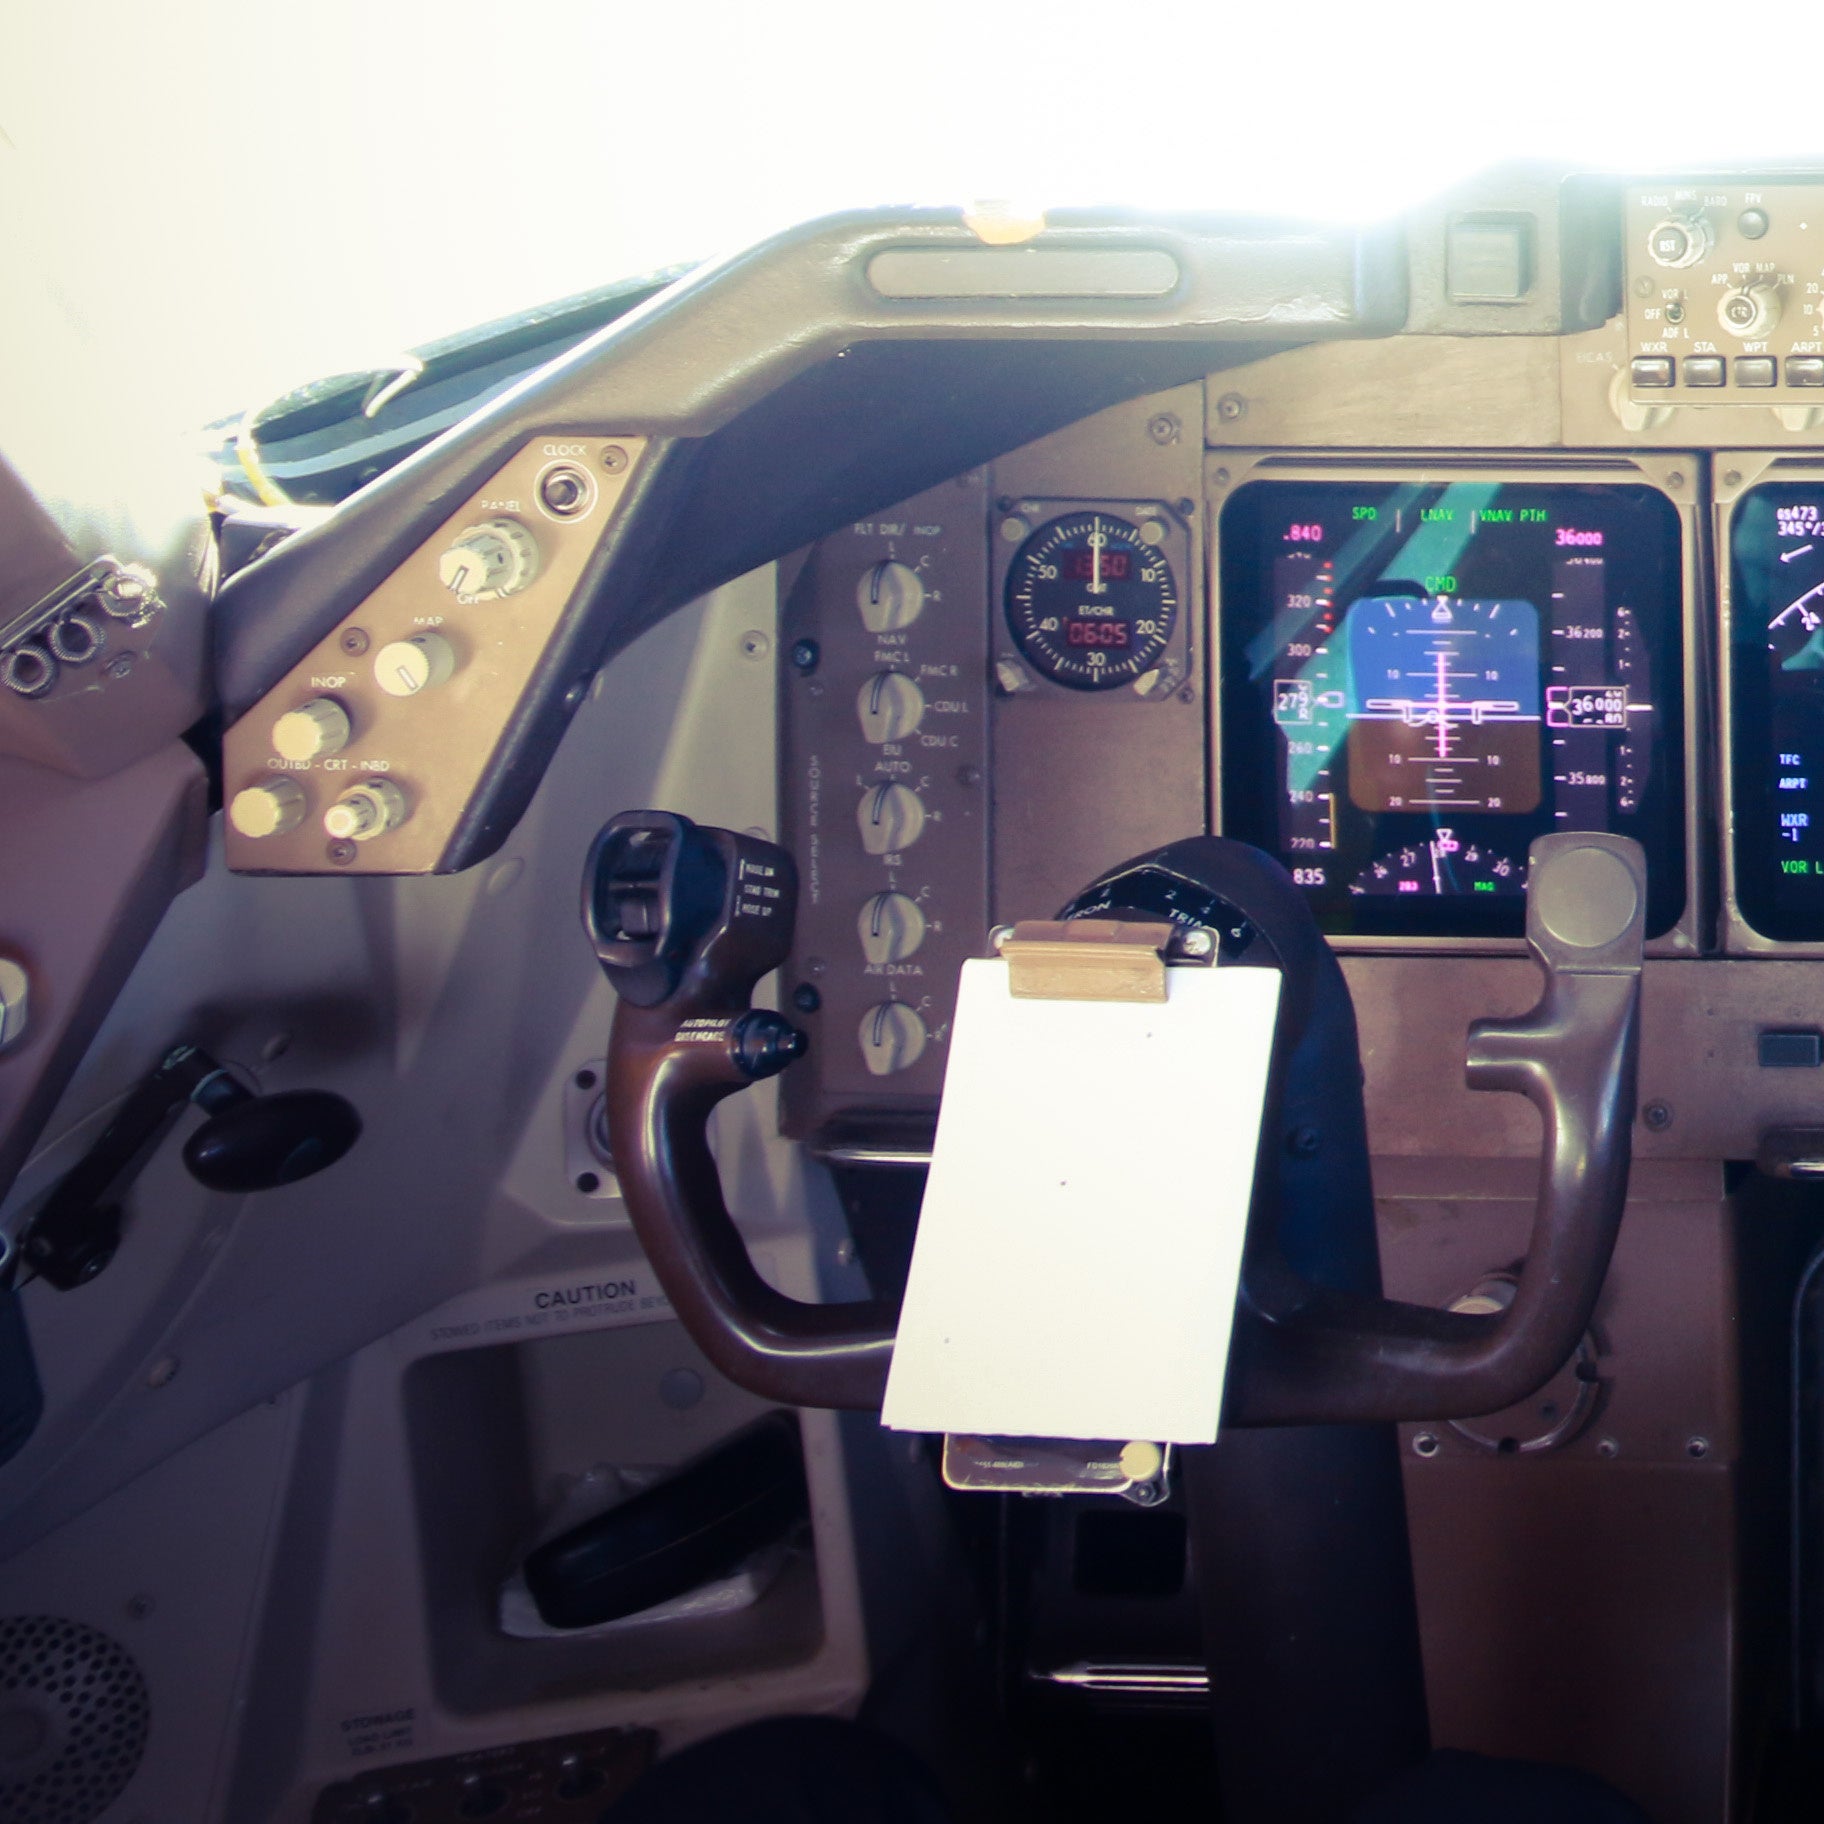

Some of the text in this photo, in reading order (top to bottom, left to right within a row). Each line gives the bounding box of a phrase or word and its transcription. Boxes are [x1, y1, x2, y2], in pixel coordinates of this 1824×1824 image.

[1284, 525, 1321, 541] .840
[1556, 529, 1602, 545] 36000
[1781, 860, 1824, 874] VOR L
[534, 1279, 637, 1310] CAUTION
